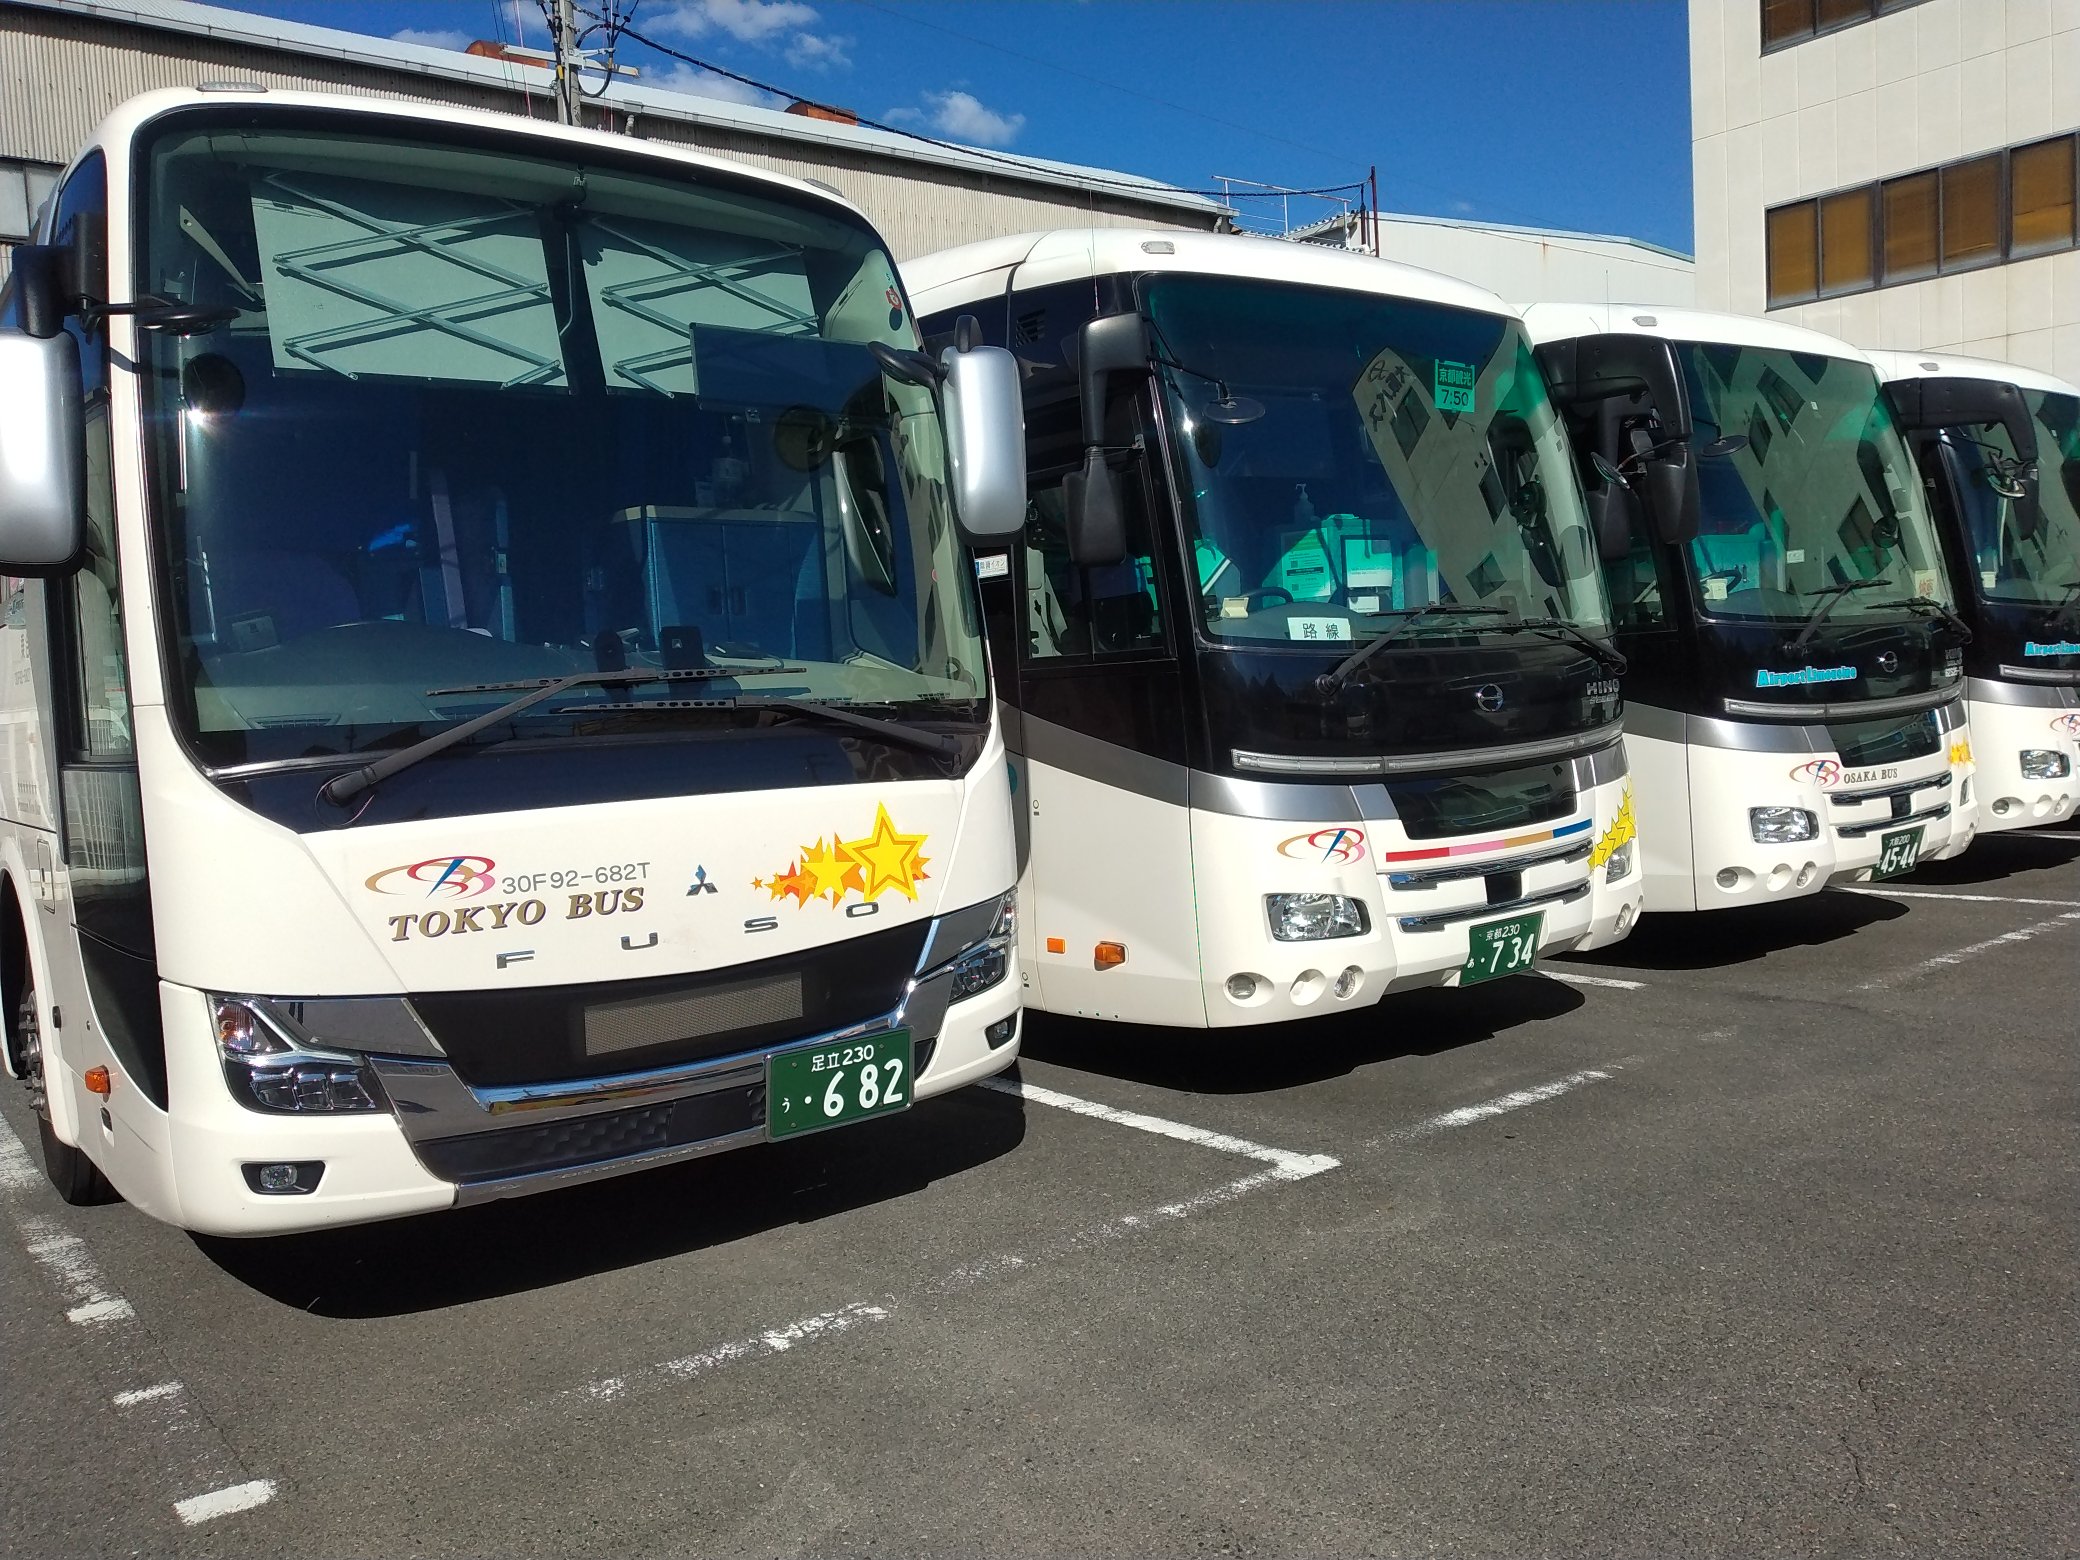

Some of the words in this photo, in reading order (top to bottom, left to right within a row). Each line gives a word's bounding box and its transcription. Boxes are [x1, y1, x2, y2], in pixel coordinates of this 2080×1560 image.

[1441, 388, 1469, 406] 7:50
[1302, 622, 1340, 640] 路線
[1586, 679, 1620, 695] HINO
[1756, 669, 1806, 687] Airport
[1843, 770, 1878, 785] OSAKA
[1881, 768, 1898, 780] BUS
[1880, 842, 1919, 873] 45-44
[502, 861, 650, 894] 30F92-682T
[388, 898, 547, 942] TOKYO
[565, 886, 645, 920] BUS
[496, 901, 879, 970] FUSO
